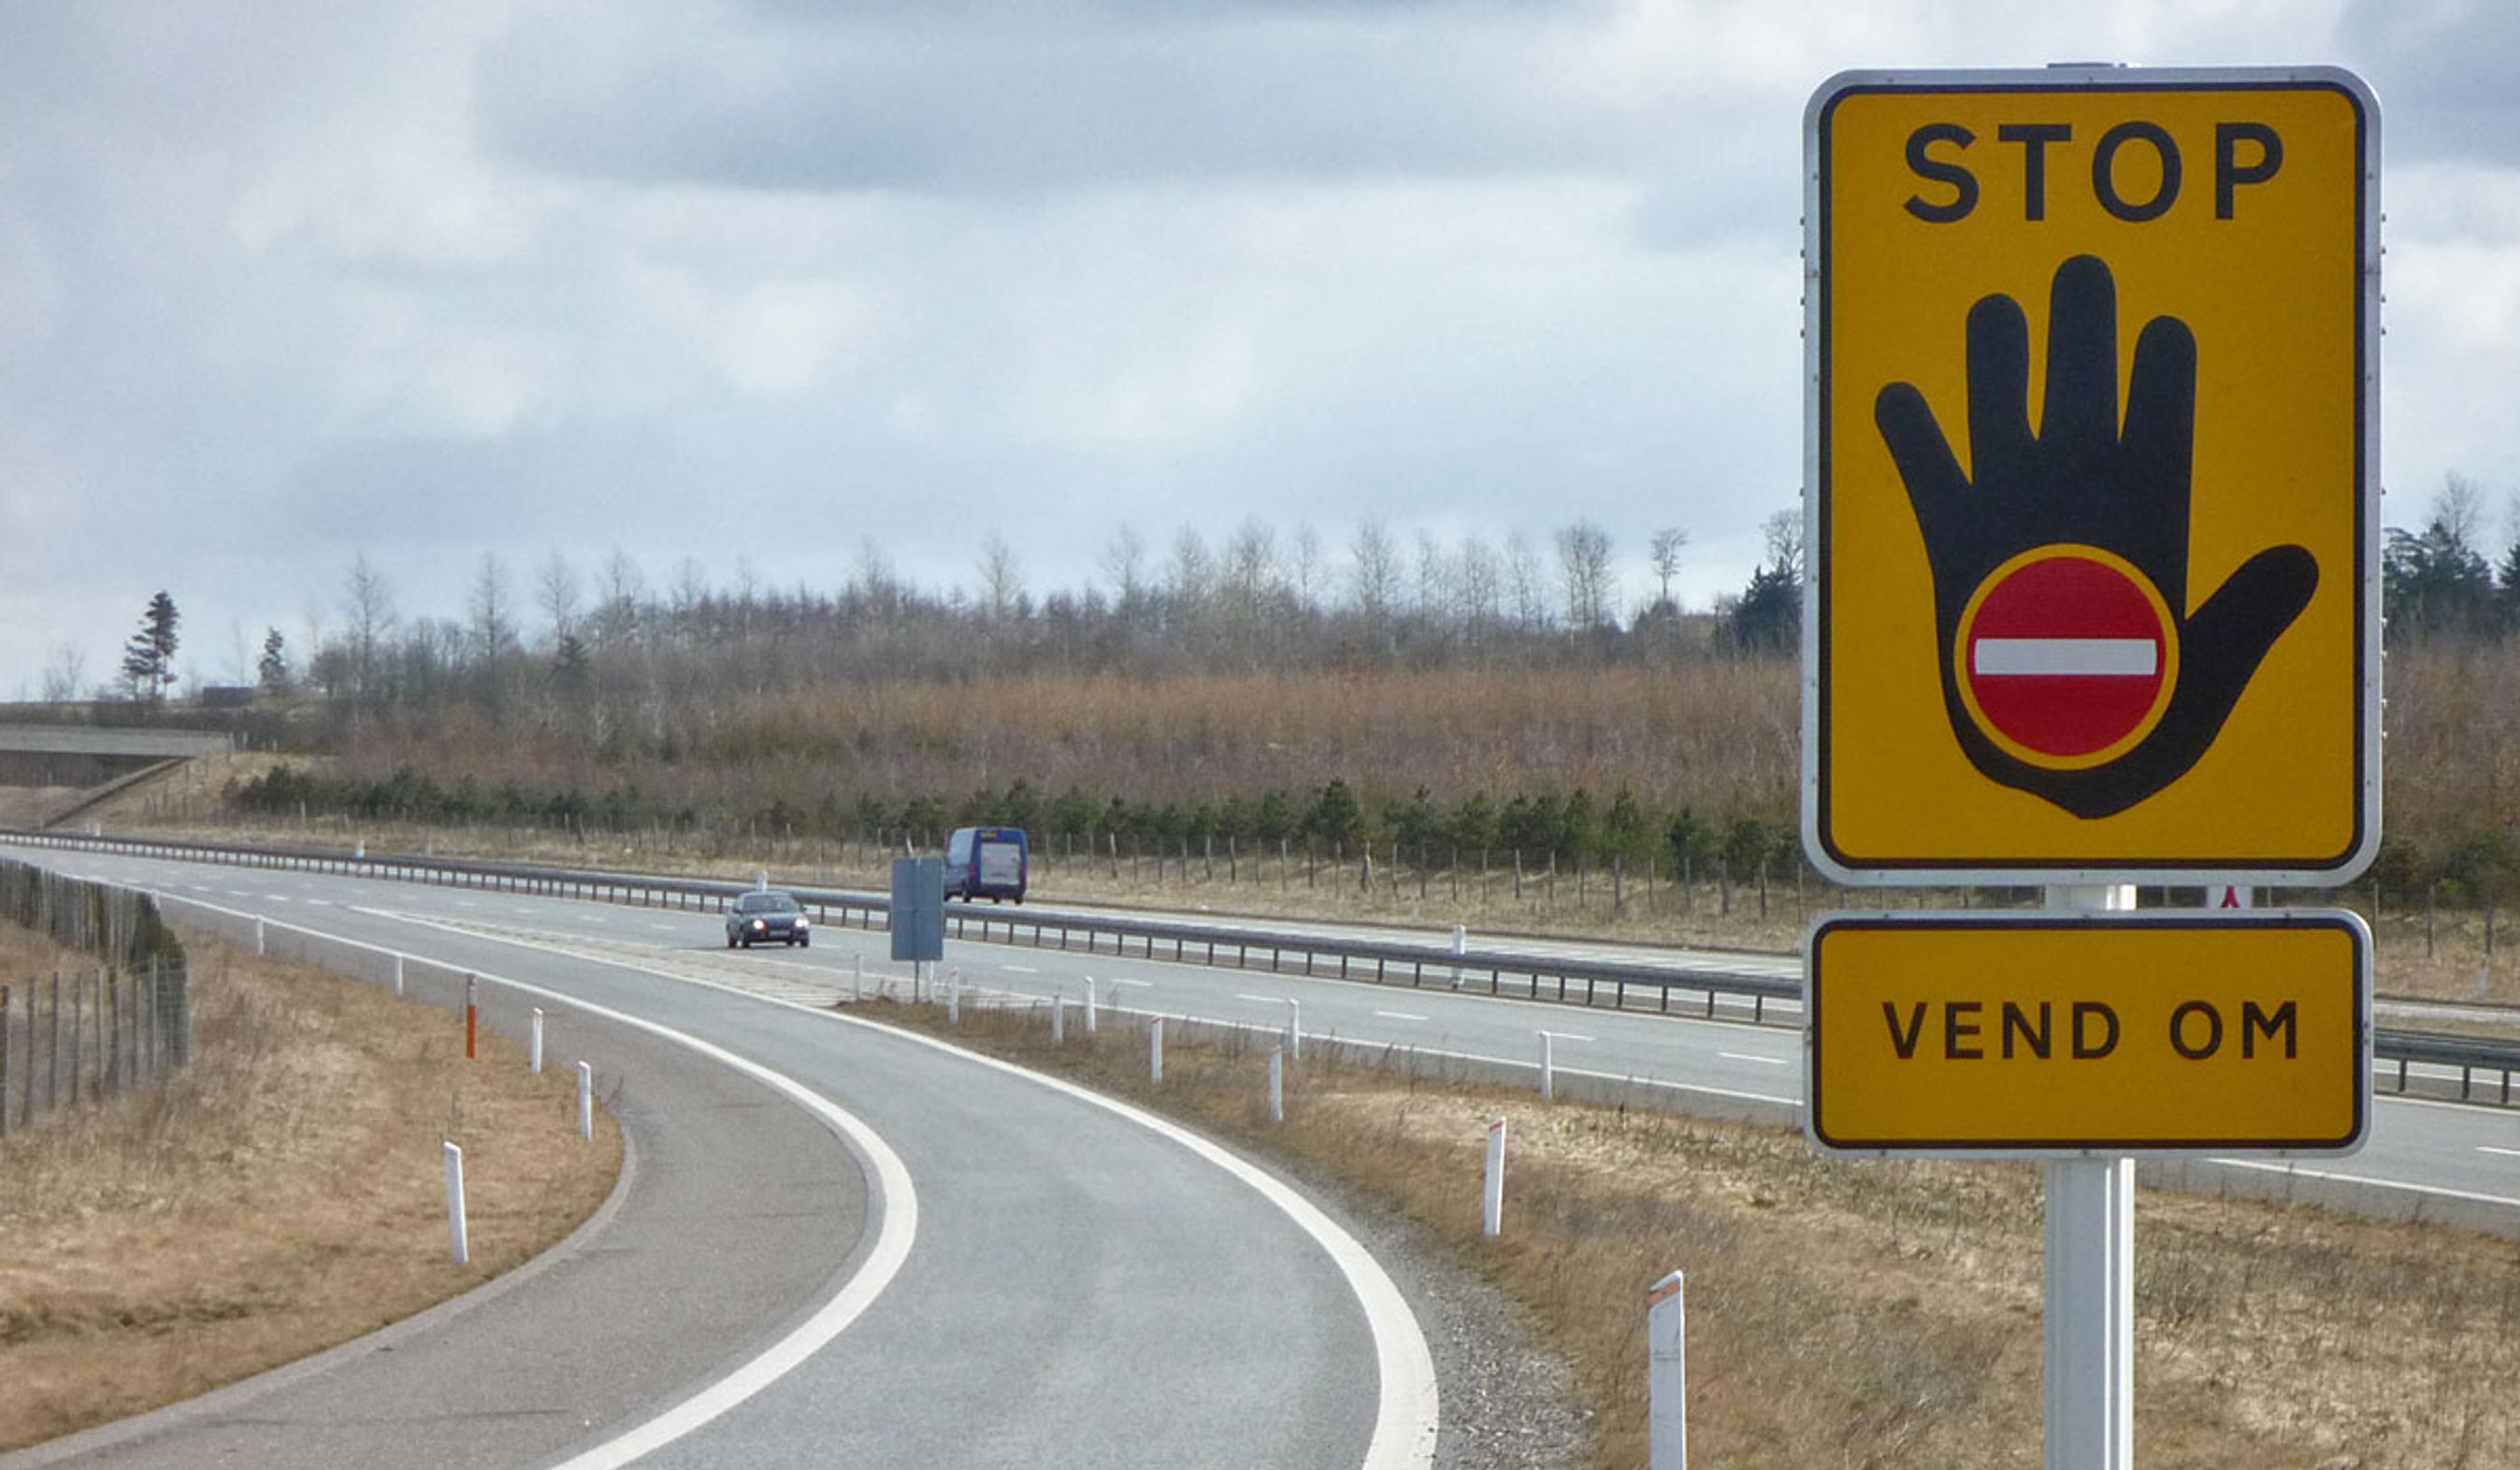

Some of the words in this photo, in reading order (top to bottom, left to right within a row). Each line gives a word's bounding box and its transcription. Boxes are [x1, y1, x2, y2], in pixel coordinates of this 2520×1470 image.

[1904, 121, 2284, 223] STOP
[1882, 1001, 2121, 1060] VEND
[2168, 1000, 2297, 1060] OM
